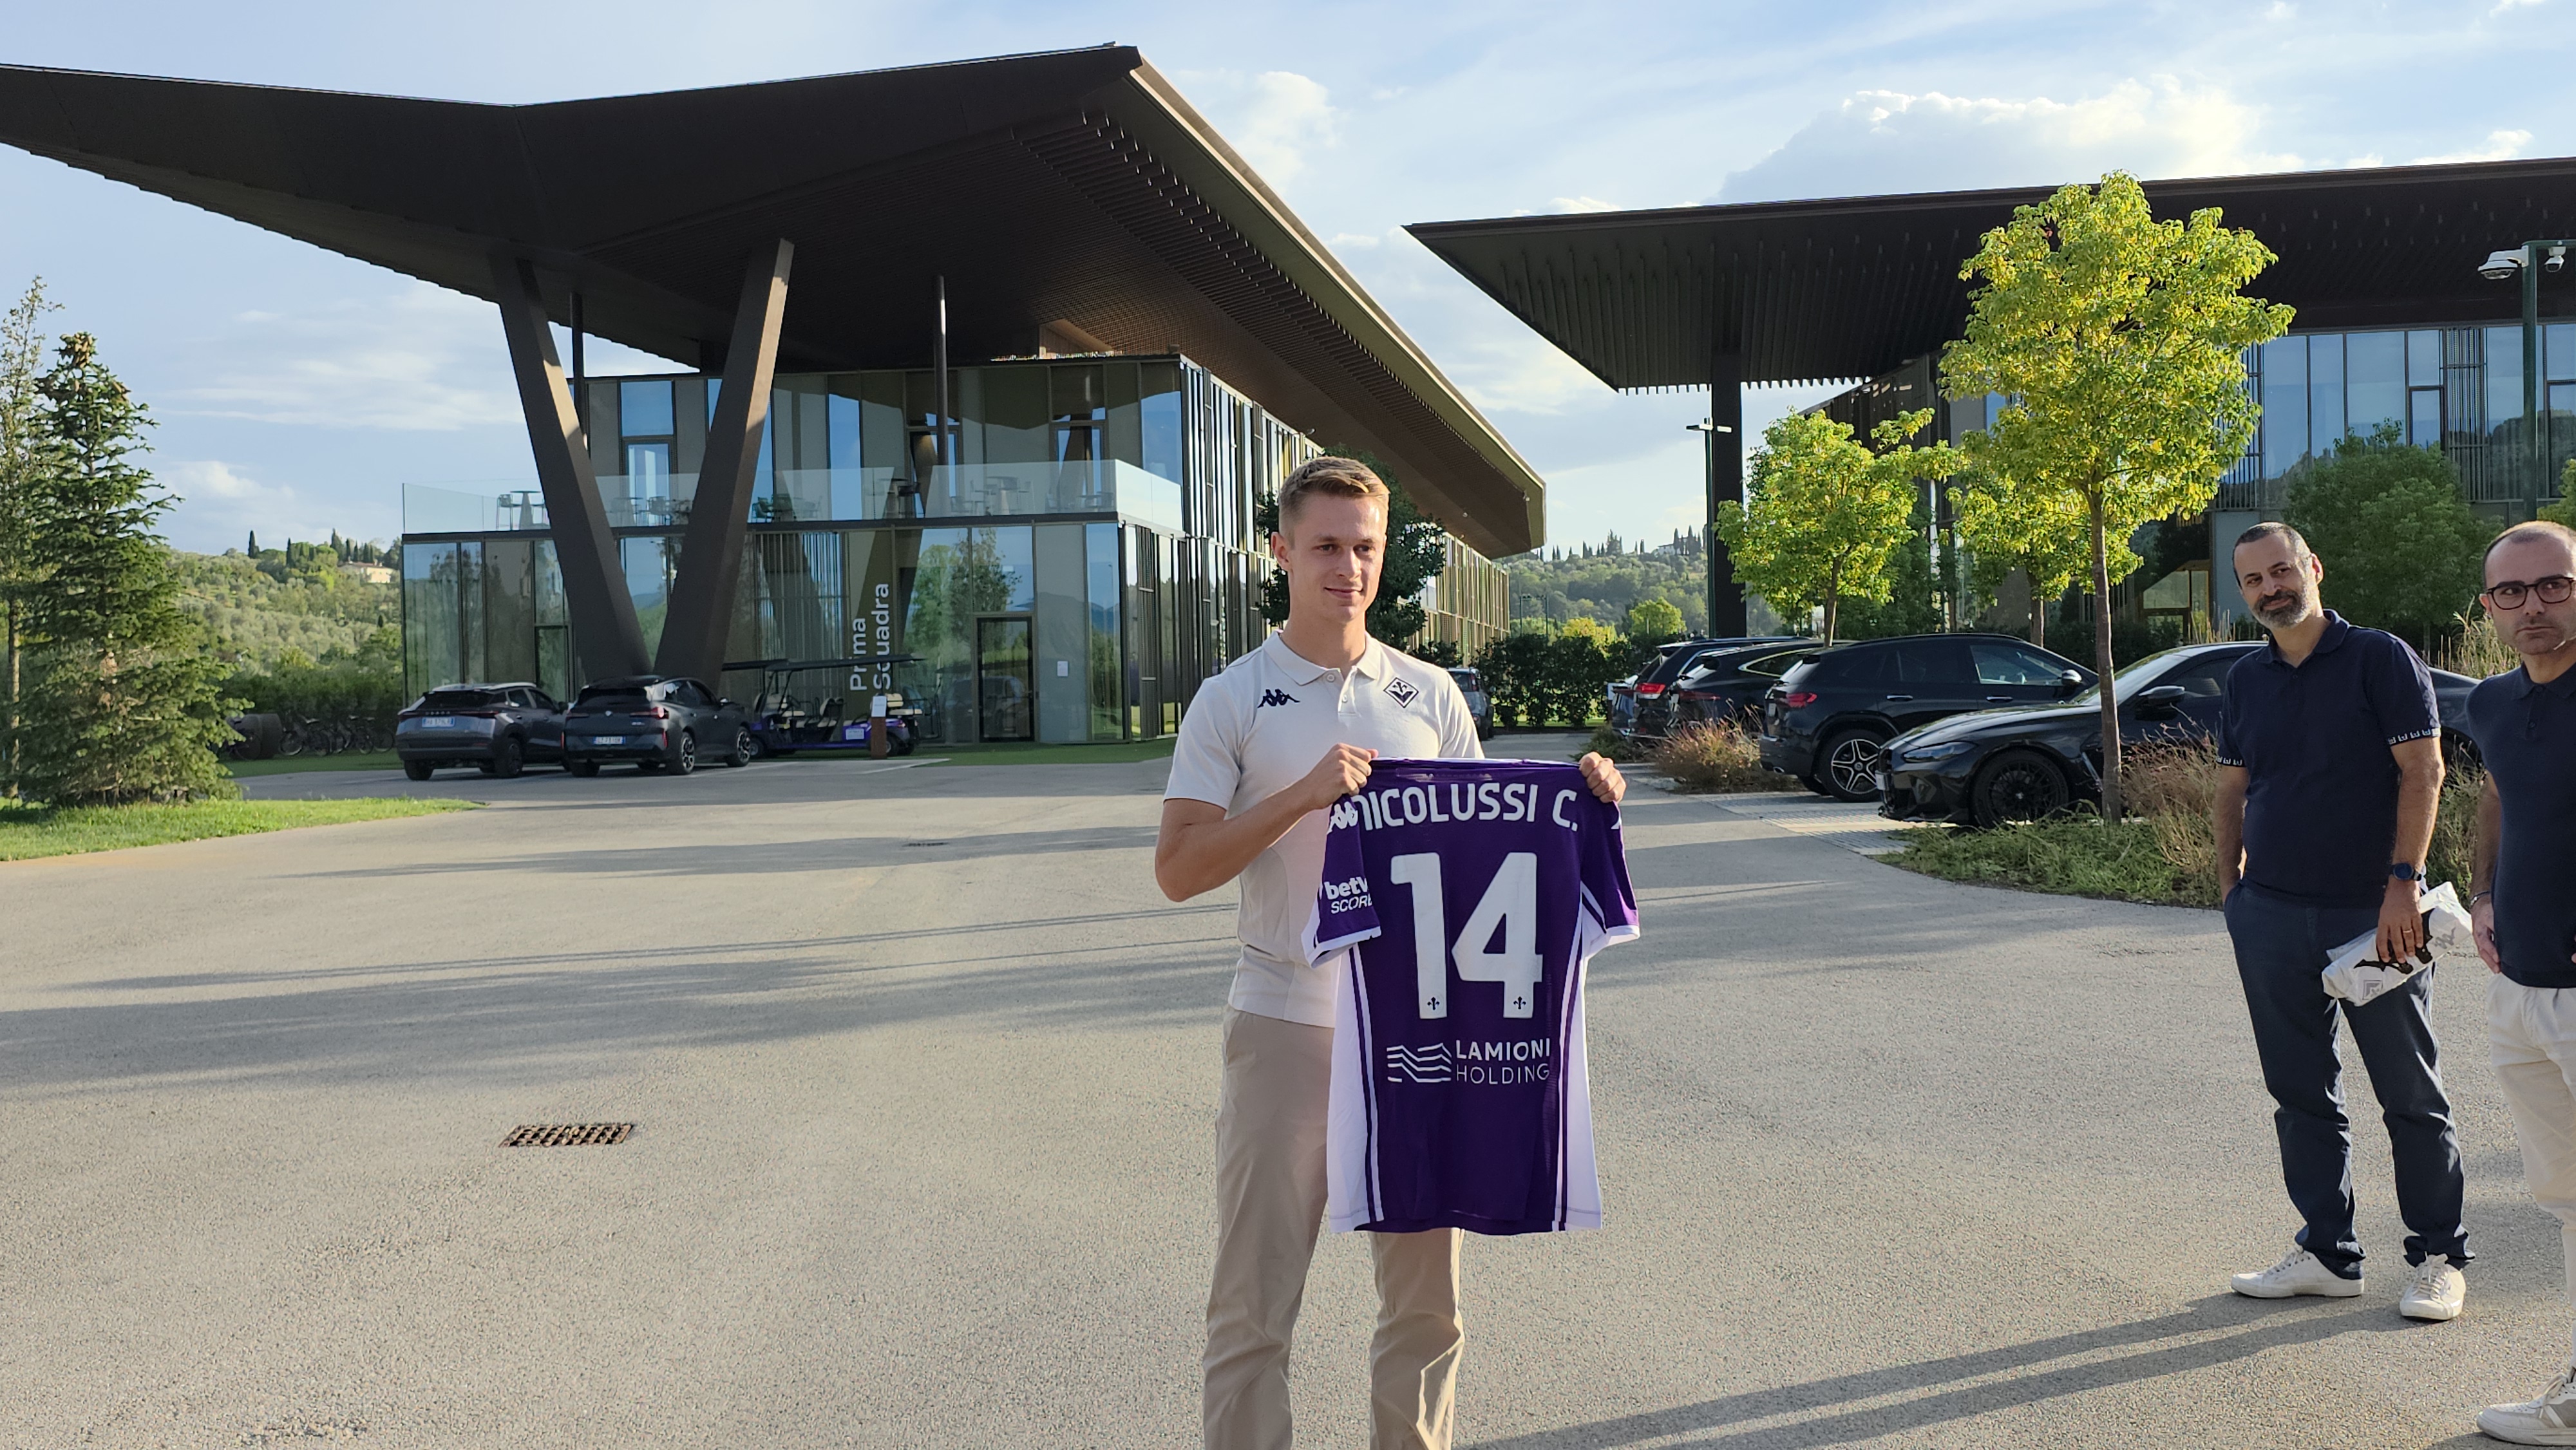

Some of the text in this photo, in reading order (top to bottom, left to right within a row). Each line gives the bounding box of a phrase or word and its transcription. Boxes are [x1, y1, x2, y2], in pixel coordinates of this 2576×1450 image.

[849, 617, 867, 691] Prma
[1552, 789, 1578, 832] C.
[1390, 852, 1543, 1019] 14
[1456, 1038, 1550, 1062] LAMIONI
[1456, 1062, 1550, 1085] HOLDING
